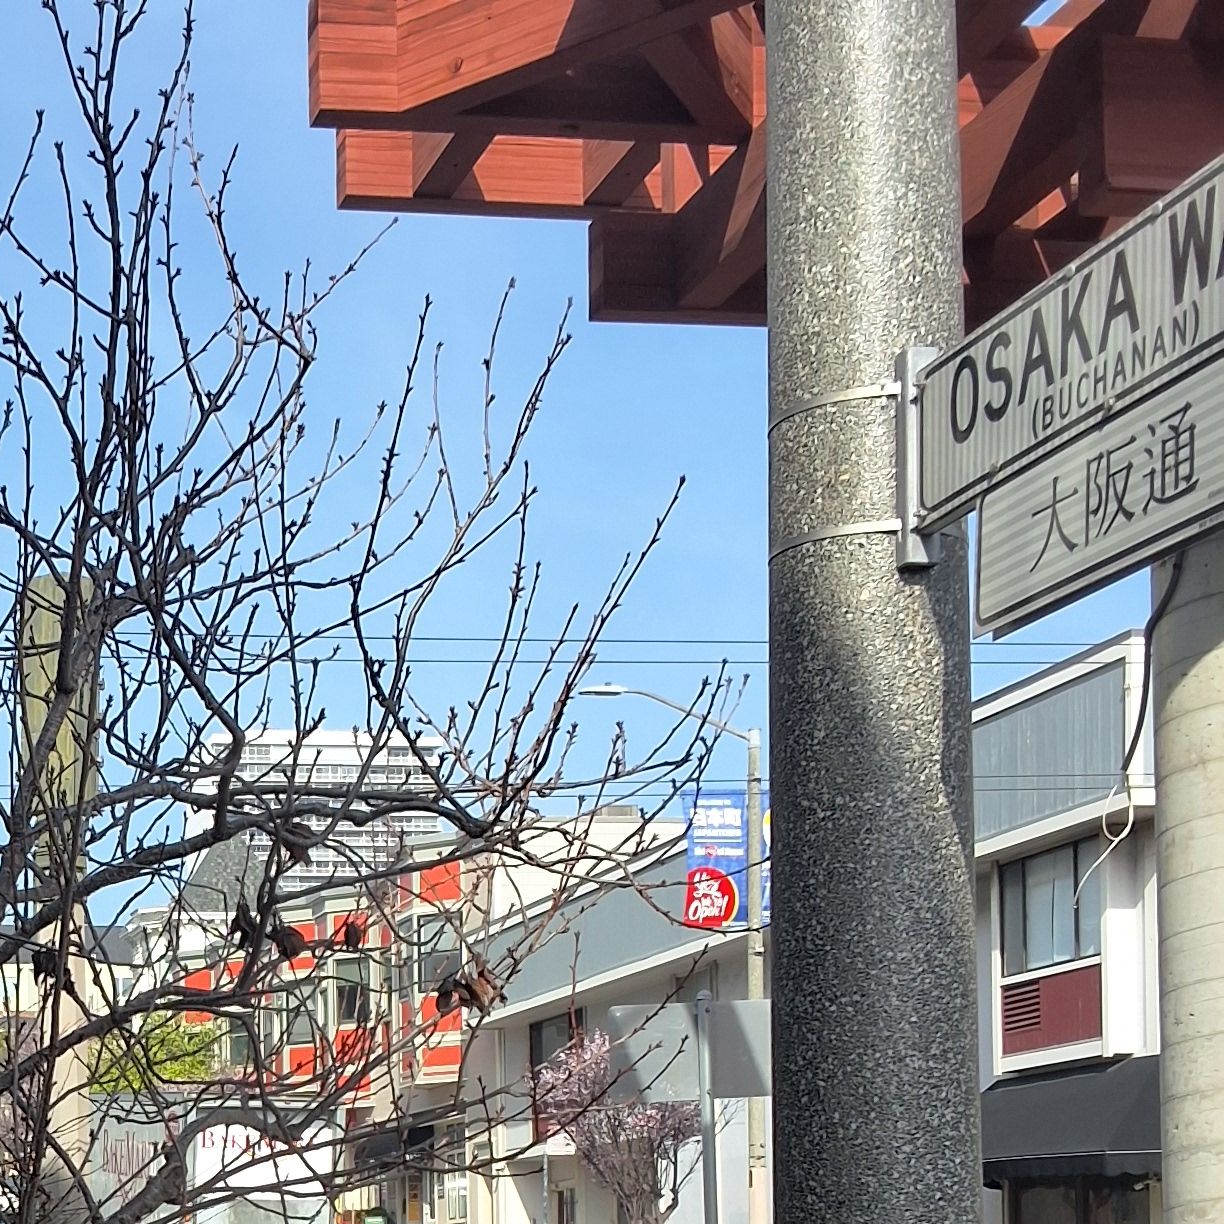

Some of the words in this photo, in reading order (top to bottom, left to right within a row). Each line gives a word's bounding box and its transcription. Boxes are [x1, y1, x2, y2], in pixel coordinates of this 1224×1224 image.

[951, 253, 1140, 444] OSAKA
[1169, 184, 1224, 305] W
[1032, 302, 1200, 439] (BUCHANAN)
[1030, 401, 1200, 575] 大阪通
